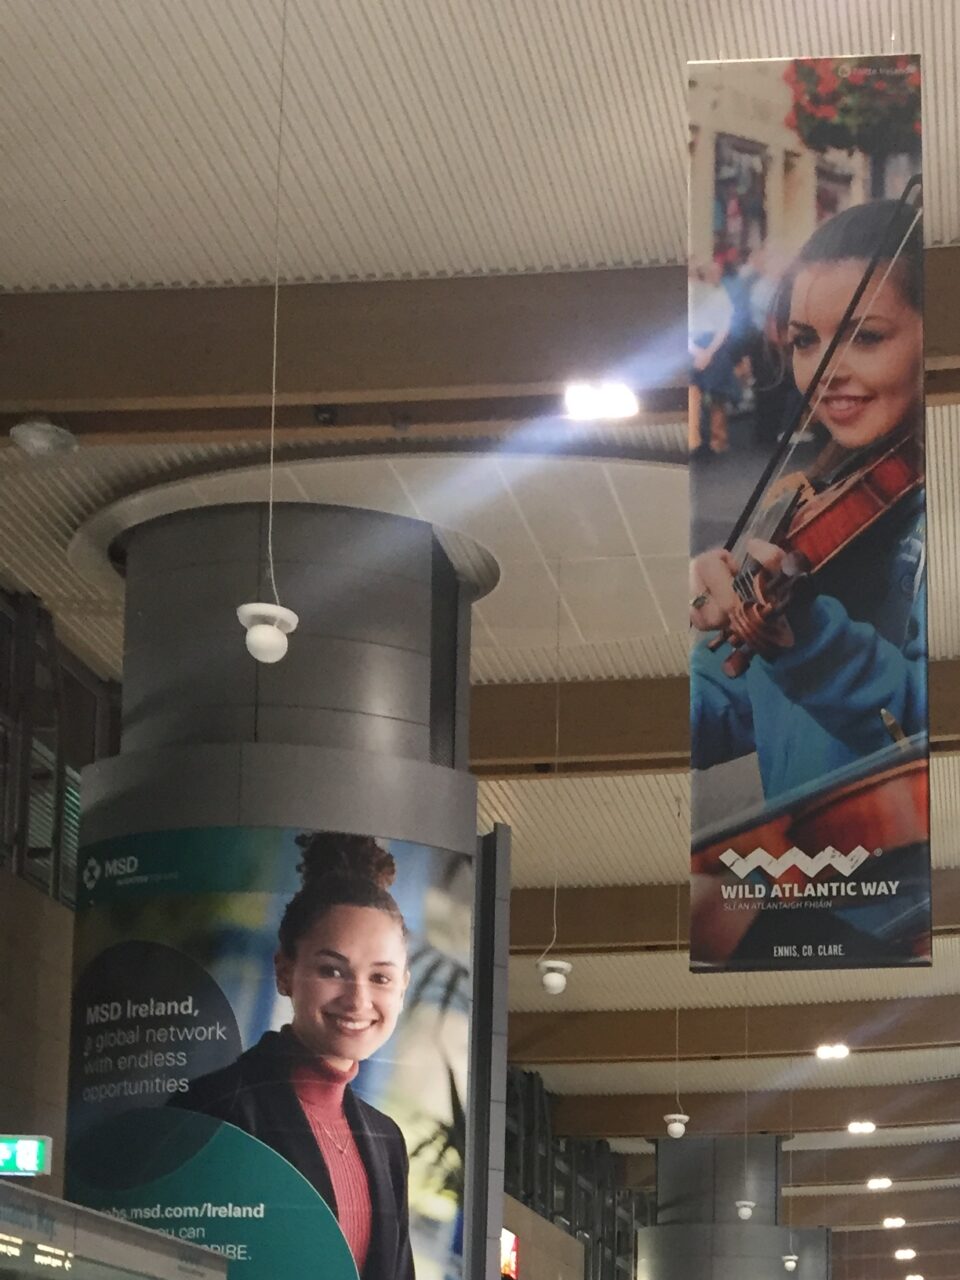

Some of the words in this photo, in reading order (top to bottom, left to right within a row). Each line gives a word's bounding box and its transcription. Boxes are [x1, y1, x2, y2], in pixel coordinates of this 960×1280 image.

[105, 856, 138, 878] MSD
[721, 884, 766, 899] WILD
[770, 882, 857, 898] ATLANTIC
[861, 881, 900, 896] WAY
[86, 1001, 121, 1025] MSD
[127, 996, 199, 1018] Ireland,
[95, 1025, 139, 1053] global
[146, 1021, 227, 1042] network
[117, 1051, 187, 1071] endless
[82, 1077, 189, 1103] opportunities
[101, 1203, 264, 1221] obs.msd.com/Ireland
[179, 1227, 205, 1239] can
